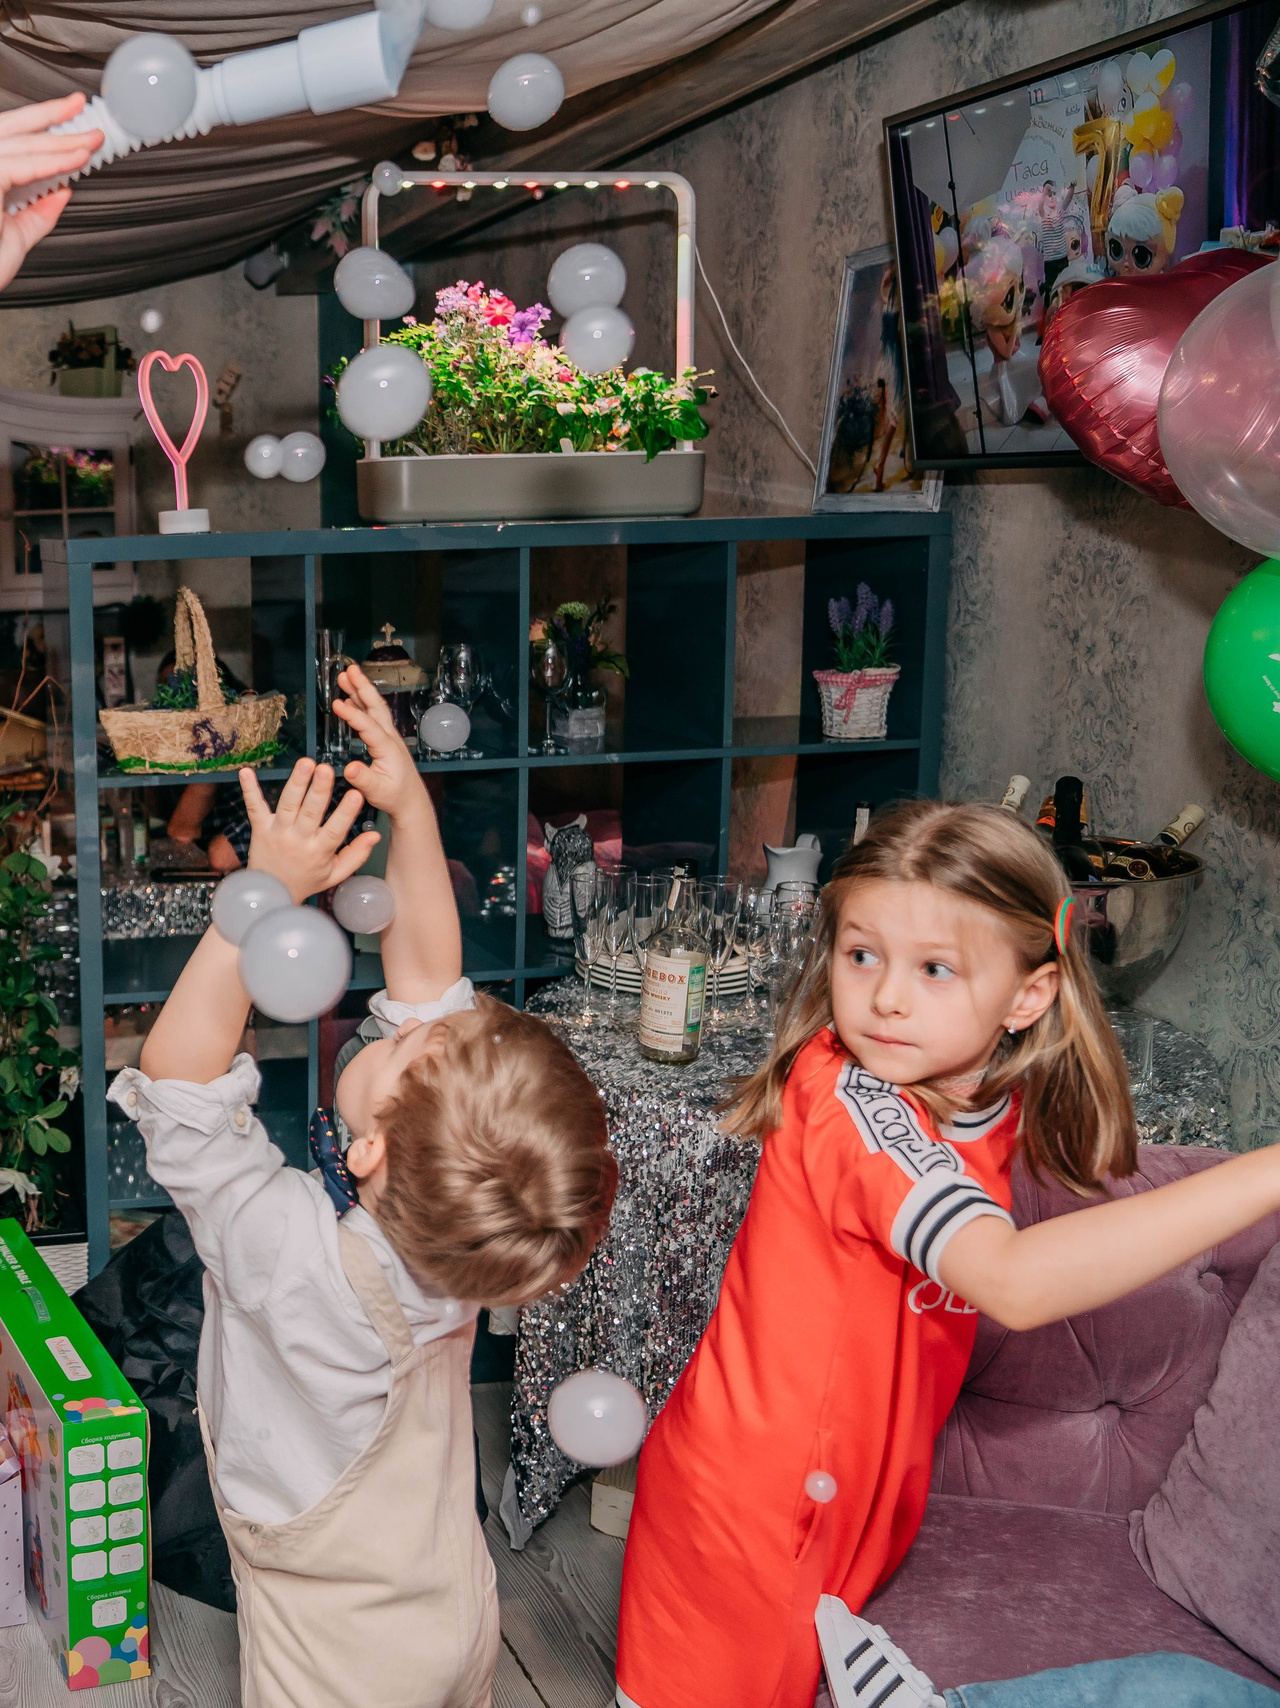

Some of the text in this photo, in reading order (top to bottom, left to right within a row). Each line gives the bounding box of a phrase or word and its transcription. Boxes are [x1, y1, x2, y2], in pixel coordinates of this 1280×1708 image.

[1011, 159, 1049, 182] Тася
[14, 1268, 32, 1285] TABLE
[86, 1592, 108, 1601] Сборка
